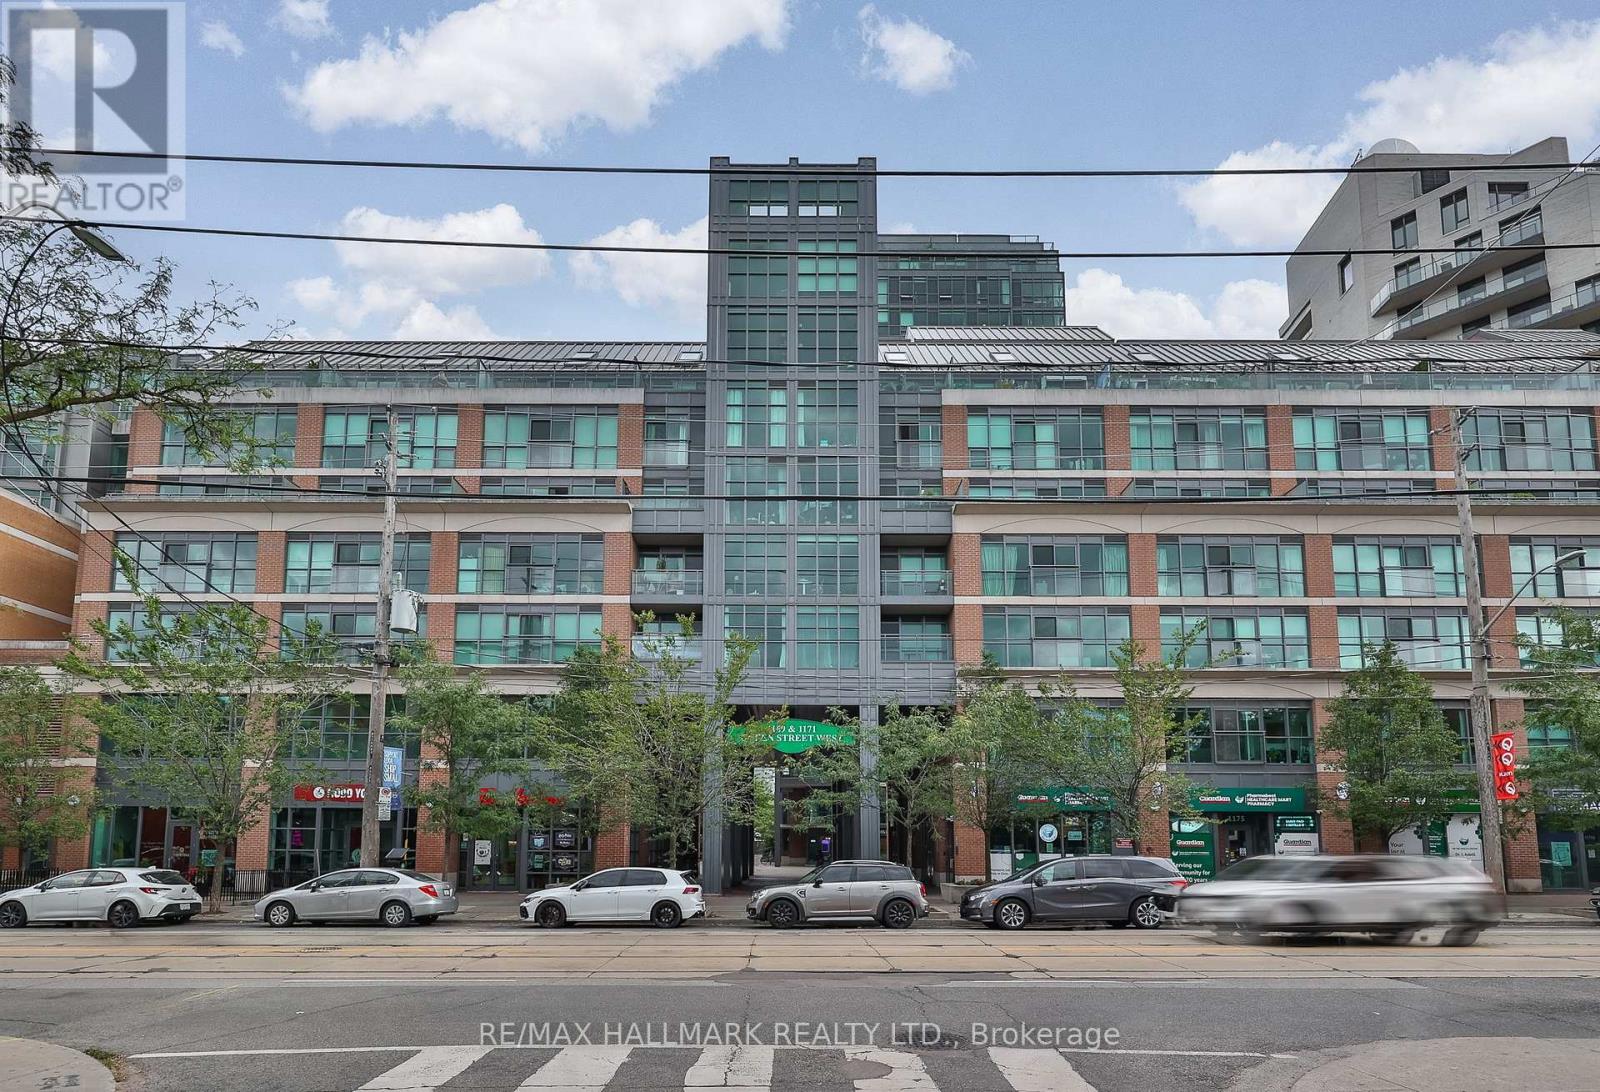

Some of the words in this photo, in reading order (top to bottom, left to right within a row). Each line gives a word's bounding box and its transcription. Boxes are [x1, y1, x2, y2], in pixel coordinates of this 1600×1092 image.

[799, 725, 816, 733] 1171
[777, 734, 813, 742] STREET
[1176, 840, 1204, 848] Guardian
